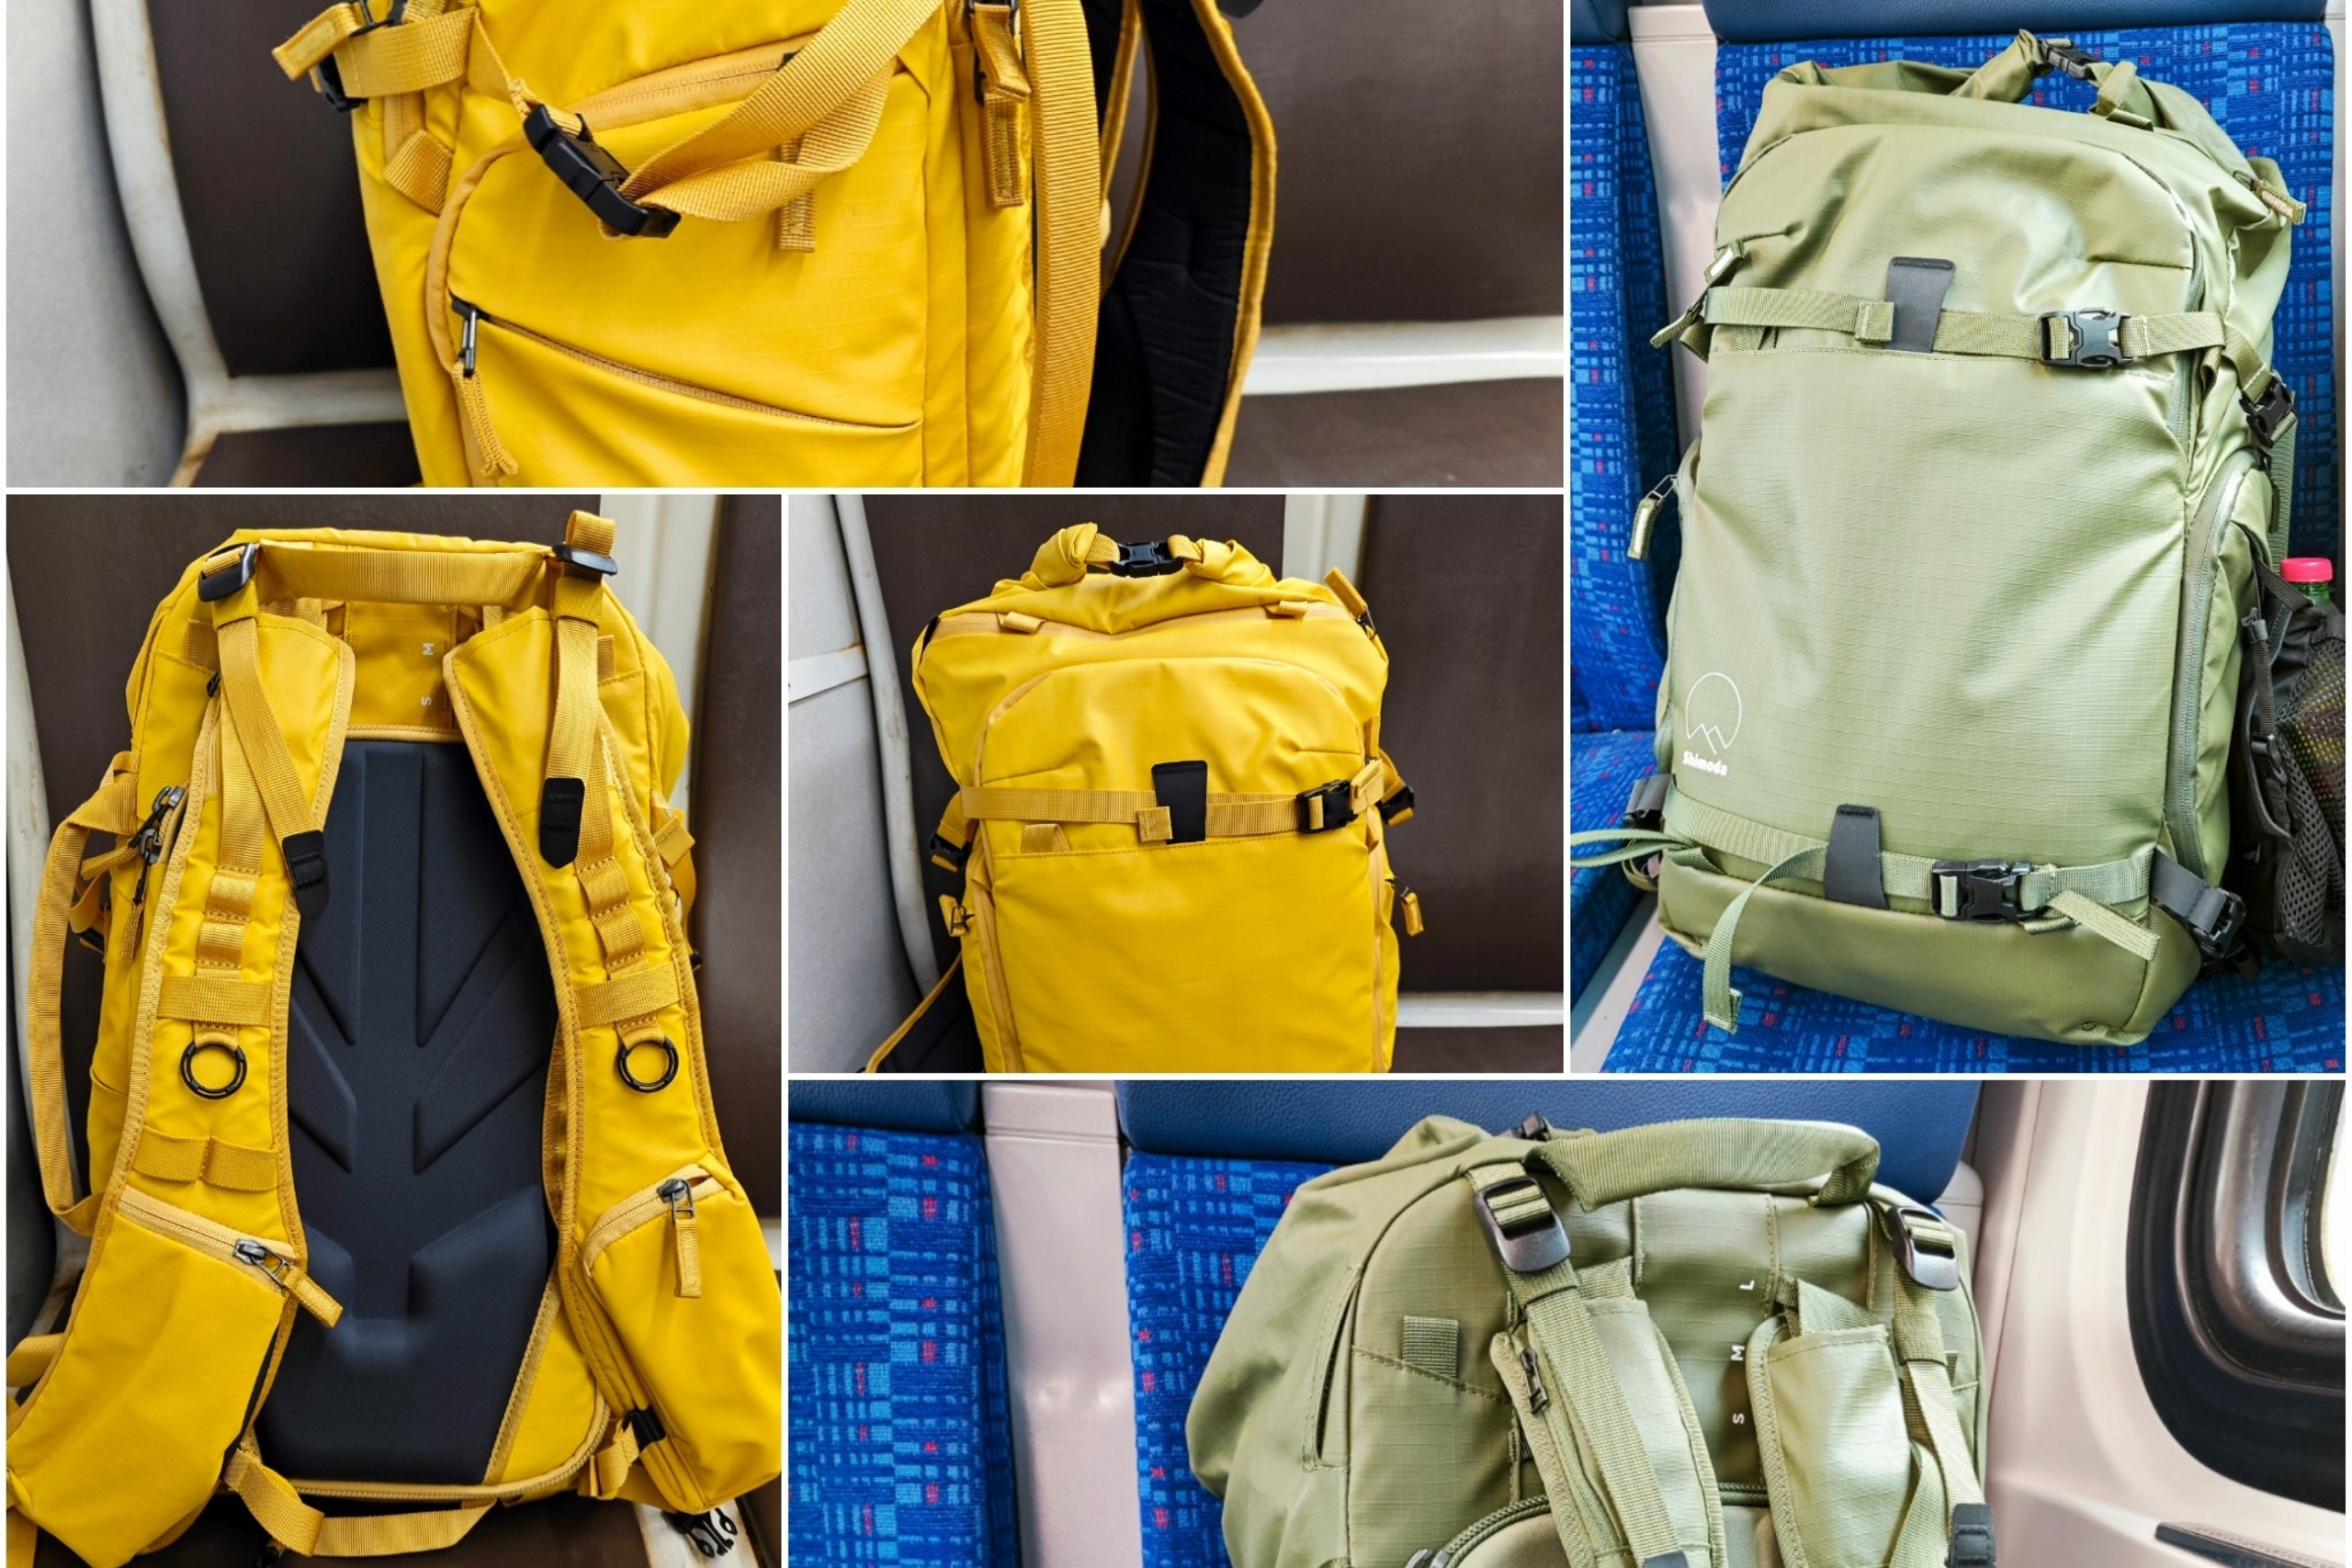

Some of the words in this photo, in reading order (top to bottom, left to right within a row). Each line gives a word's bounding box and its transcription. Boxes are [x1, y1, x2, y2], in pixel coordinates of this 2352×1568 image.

[423, 643, 435, 656] M
[421, 696, 432, 706] S
[1682, 750, 1728, 776] Shimoda
[1739, 1280, 1755, 1291] L
[1730, 1345, 1746, 1361] M
[1732, 1413, 1745, 1425] S
